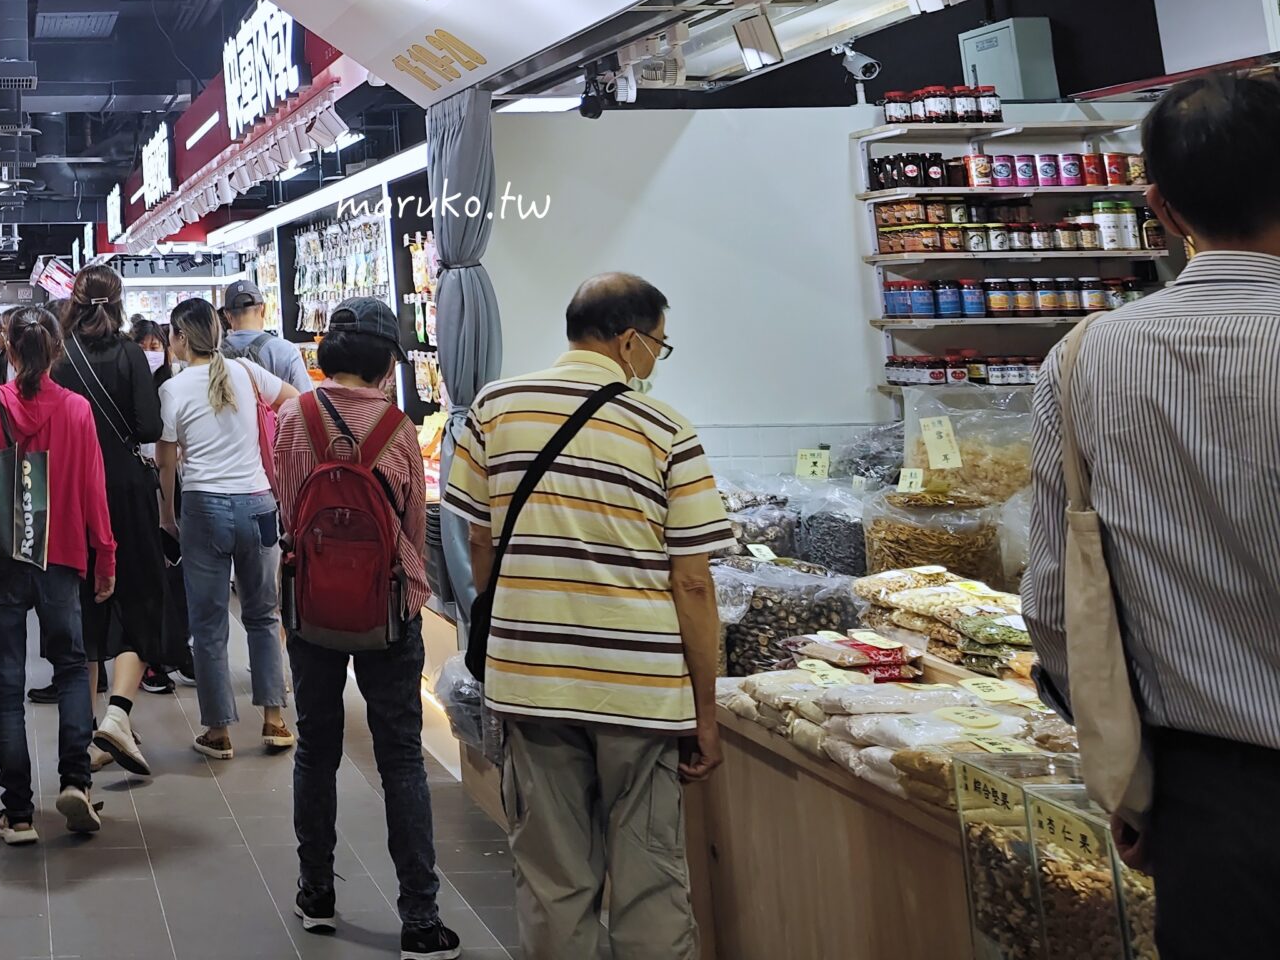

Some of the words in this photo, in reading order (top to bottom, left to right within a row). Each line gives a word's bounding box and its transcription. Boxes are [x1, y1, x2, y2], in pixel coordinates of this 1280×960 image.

[21, 491, 35, 558] Roots
[1047, 816, 1092, 854] 杏仁果
